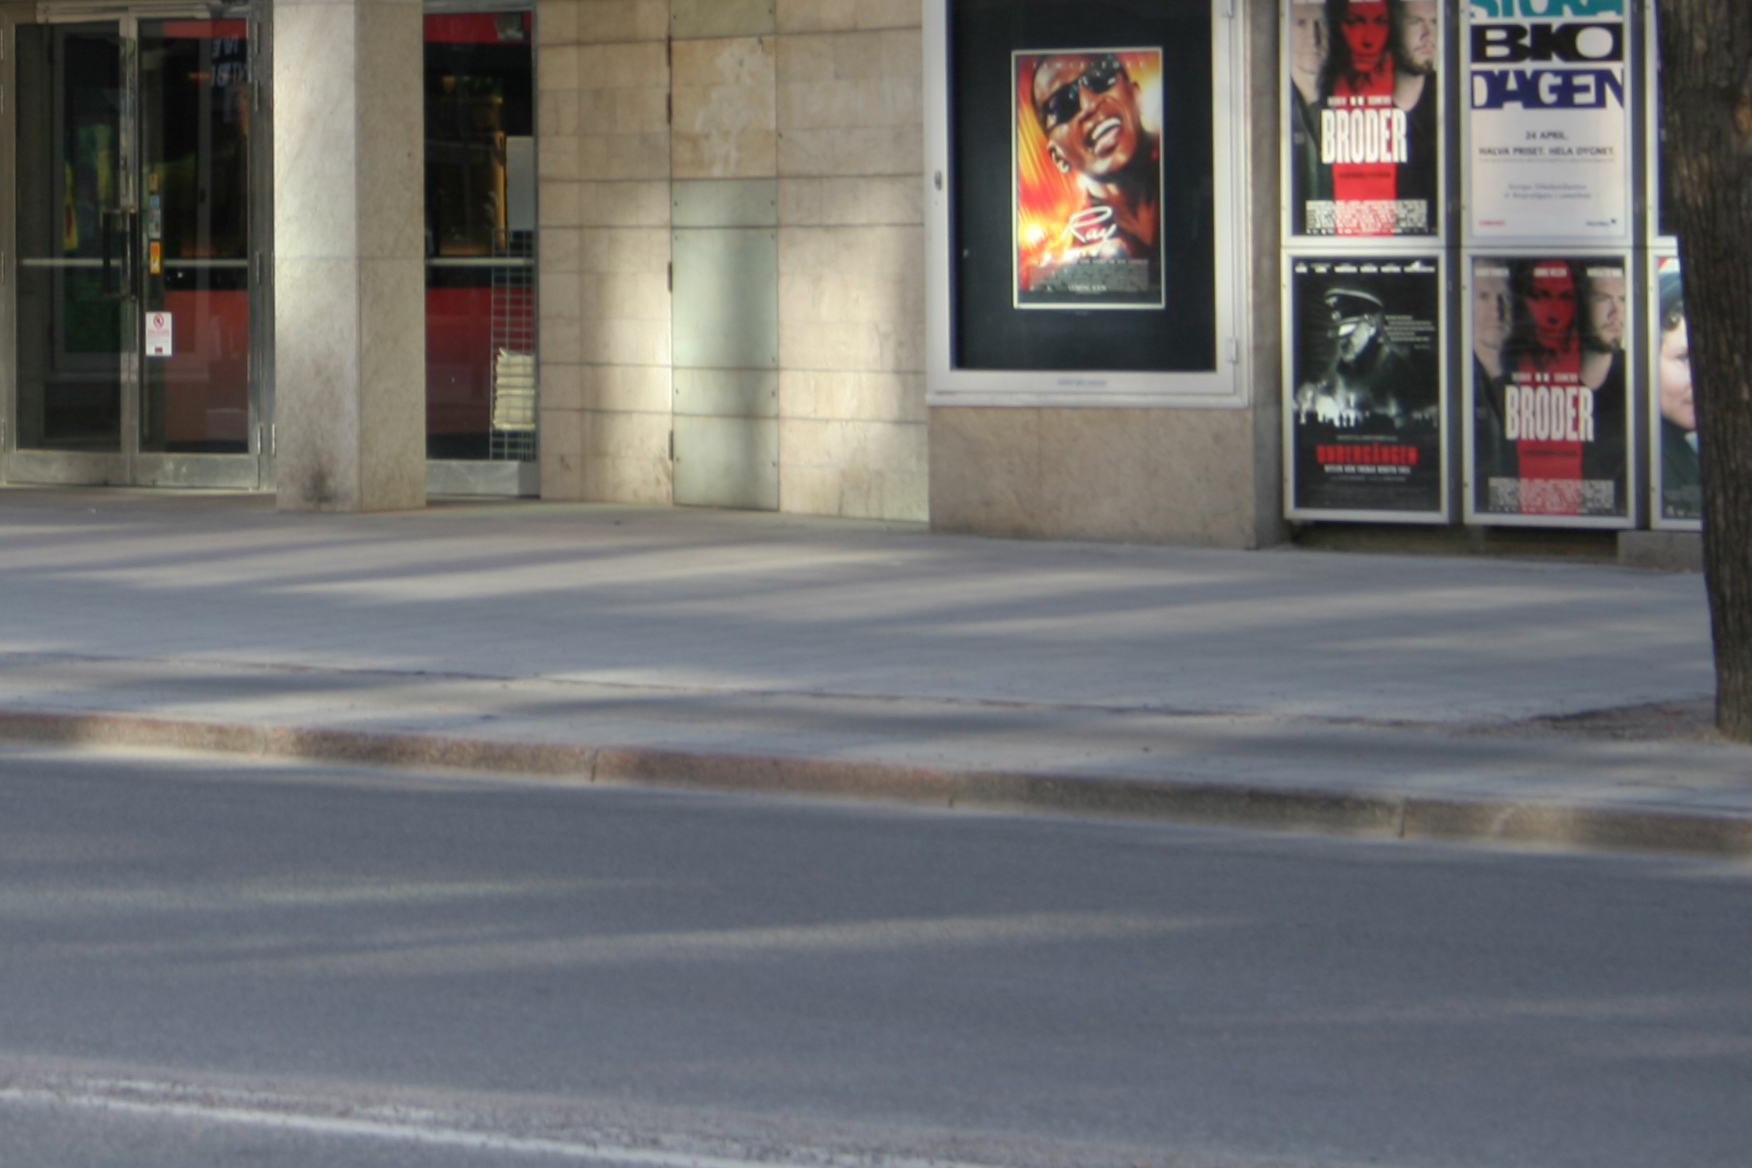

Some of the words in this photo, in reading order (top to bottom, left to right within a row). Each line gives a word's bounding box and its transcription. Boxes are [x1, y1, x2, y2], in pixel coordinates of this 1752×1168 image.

[1471, 23, 1623, 63] BIO
[1471, 68, 1624, 109] DAGEN
[1060, 205, 1118, 248] Ray
